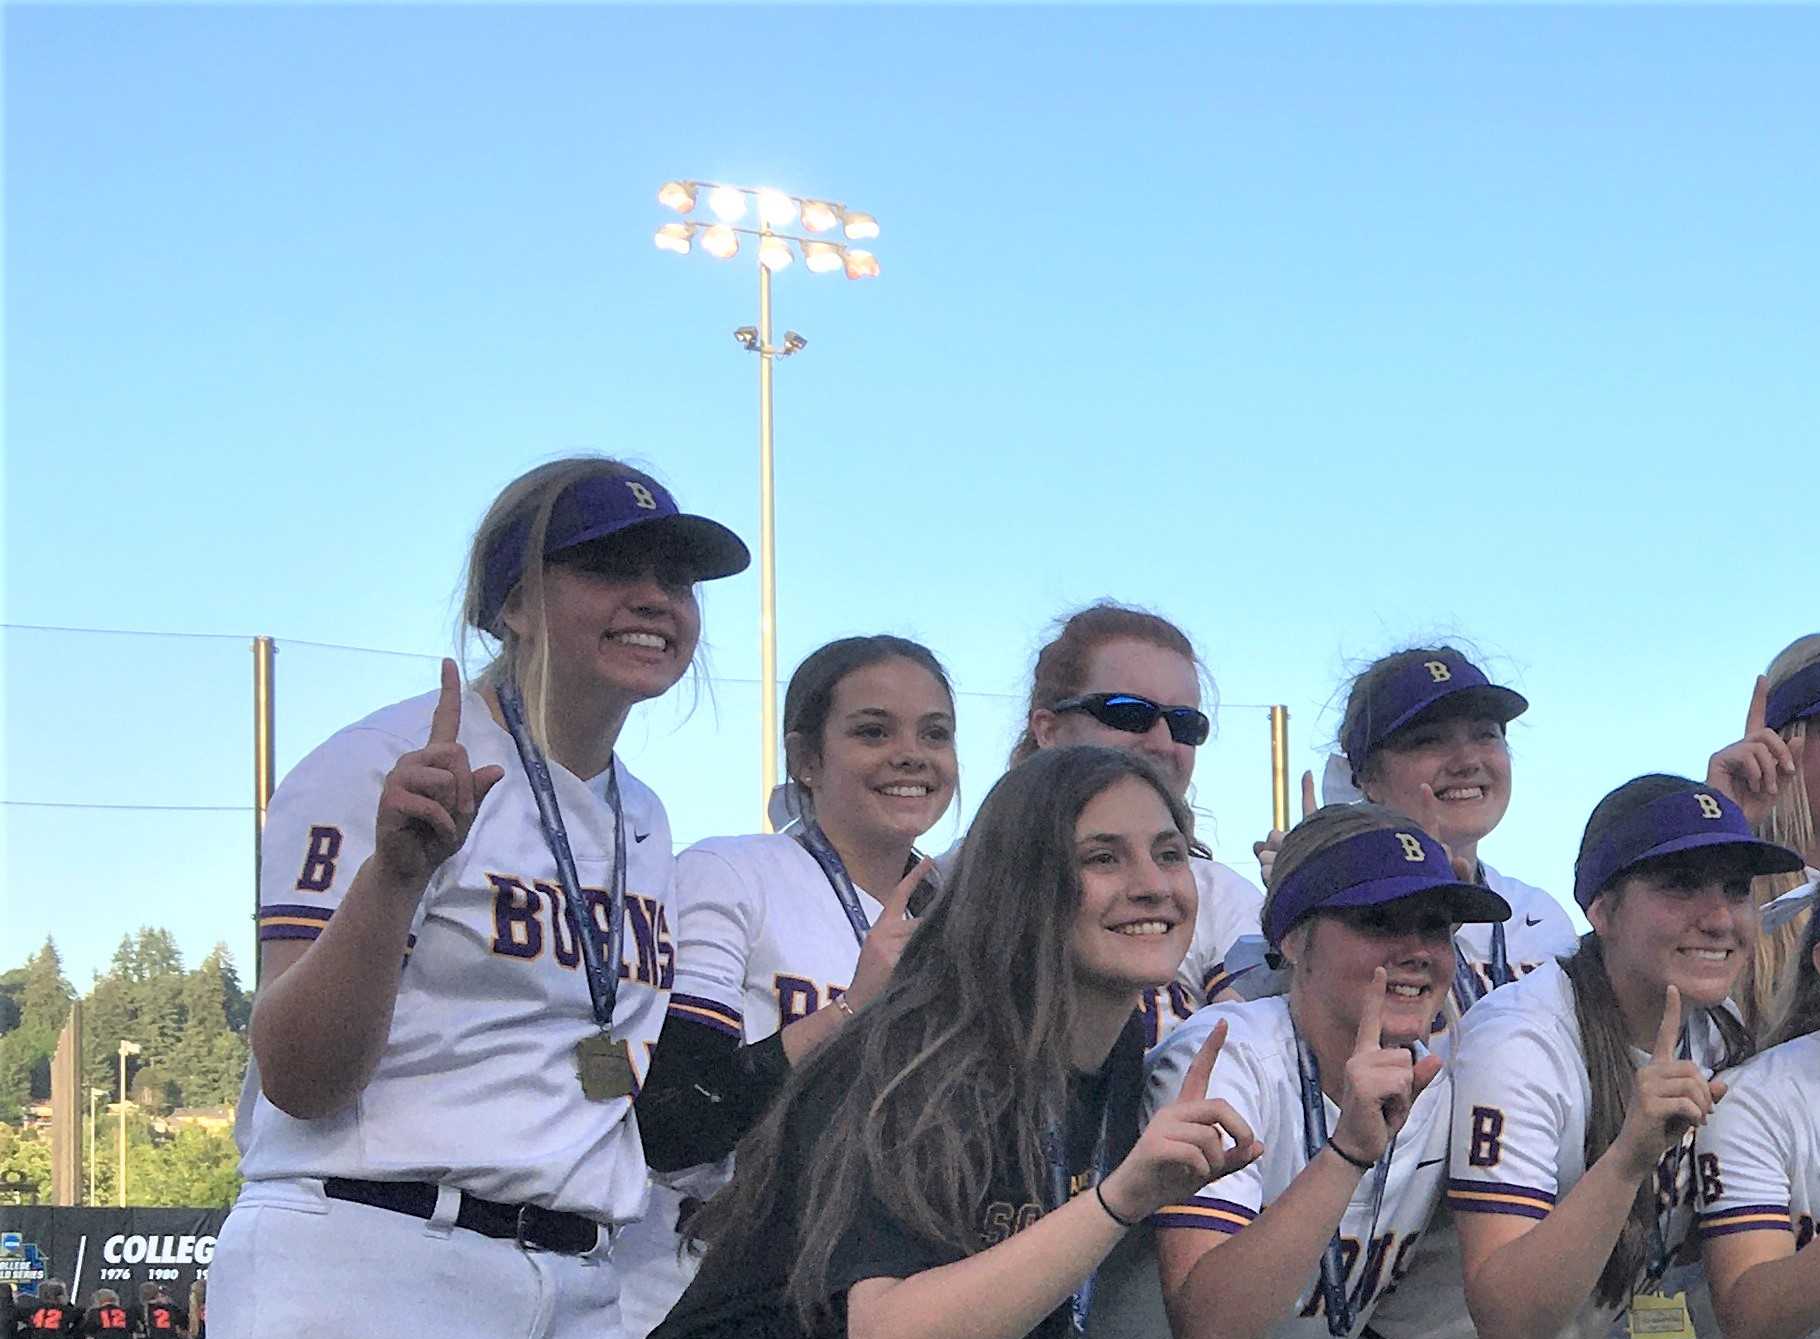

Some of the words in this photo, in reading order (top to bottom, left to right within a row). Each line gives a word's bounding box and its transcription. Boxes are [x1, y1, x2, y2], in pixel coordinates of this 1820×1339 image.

[625, 480, 656, 510] B
[1425, 661, 1452, 683] B
[1694, 794, 1723, 821] B
[297, 825, 343, 892] B
[1396, 833, 1426, 862] B
[1469, 1106, 1505, 1168] B
[1698, 1152, 1725, 1204] B
[103, 1235, 218, 1264] COLLEG
[101, 1268, 130, 1280] 1976
[148, 1268, 178, 1280] 1980
[99, 1308, 126, 1329] 12
[153, 1308, 171, 1329] 2
